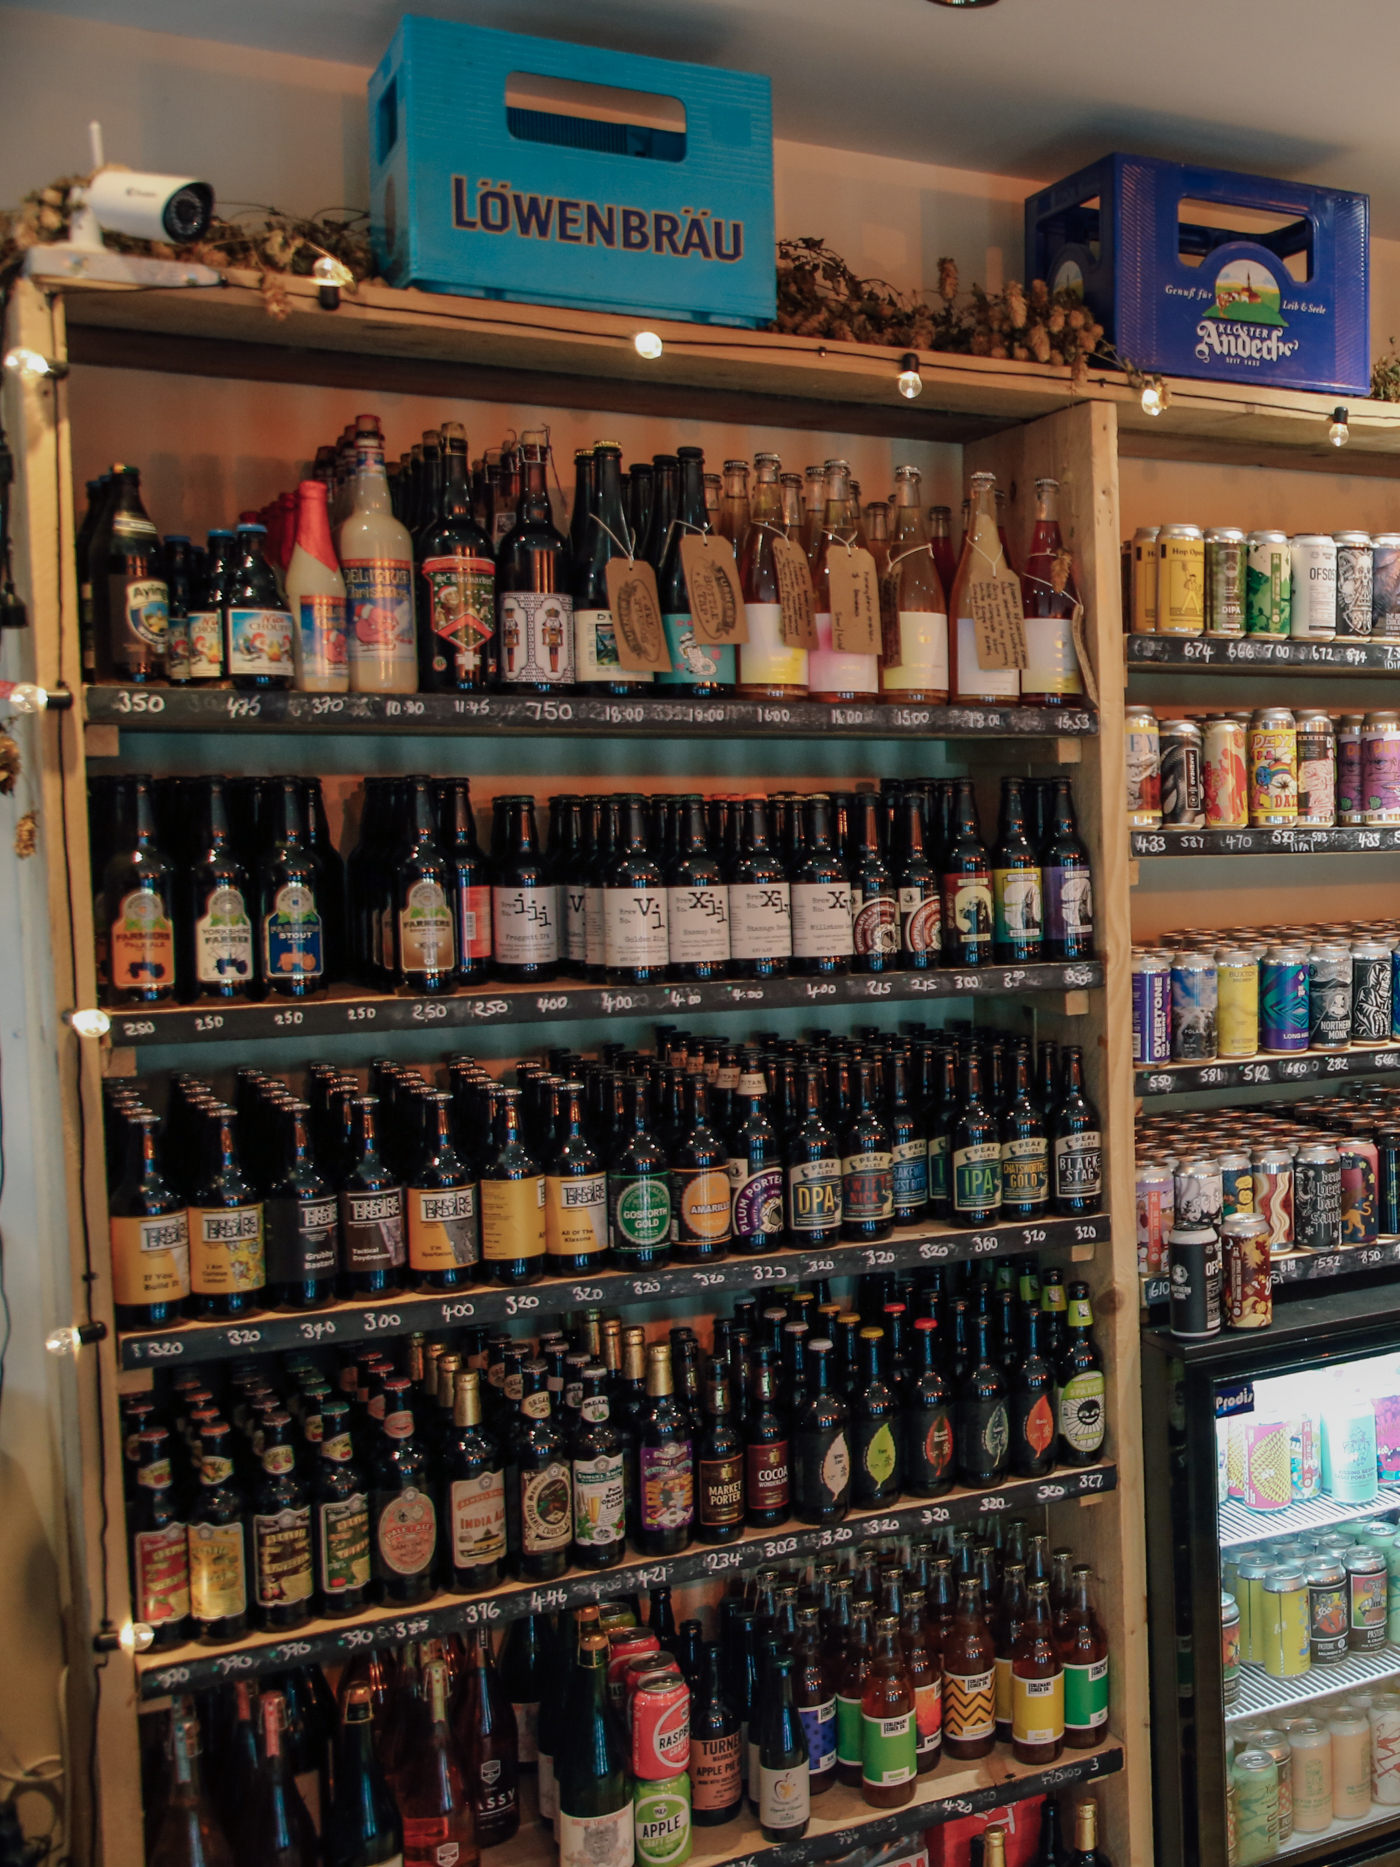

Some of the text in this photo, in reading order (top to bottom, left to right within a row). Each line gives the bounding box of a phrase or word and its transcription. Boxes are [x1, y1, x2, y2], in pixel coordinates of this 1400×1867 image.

[451, 174, 743, 263] LÖWENBRÄU
[1199, 289, 1213, 300] für
[1282, 300, 1299, 311] Leib
[1308, 303, 1326, 314] Seele
[1218, 325, 1269, 338] KLOSTER
[1196, 321, 1299, 363] Andechs
[1222, 606, 1241, 615] DIPA
[1184, 642, 1213, 663] 674
[1266, 645, 1289, 658] 700
[1312, 647, 1334, 661] 672
[119, 693, 165, 714] 350
[312, 698, 344, 715] 370
[529, 700, 572, 720] 750
[1226, 834, 1251, 848] 470
[279, 932, 313, 940] STOUT
[275, 1011, 304, 1026] 250
[347, 1007, 377, 1021] 250
[413, 1004, 448, 1020] 250
[1154, 977, 1163, 1058] OVERTONE
[124, 1022, 155, 1036] 250
[195, 1015, 224, 1031] 250
[1328, 1031, 1347, 1039] MONK
[1327, 1057, 1348, 1071] 282
[973, 1146, 995, 1154] PEAK
[1016, 1141, 1041, 1149] PEAK
[811, 1162, 836, 1171] PEAK
[858, 1156, 885, 1164] PEAK
[1059, 1154, 1099, 1171] BLACK
[816, 1168, 833, 1176] ALES
[1003, 1163, 1044, 1175] CHATSWORTH
[1066, 1169, 1094, 1182] STAG
[965, 1169, 993, 1194] IPA
[1010, 1172, 1038, 1188] GOLD
[799, 1186, 836, 1215] DPA
[624, 1208, 667, 1219] GOSFORTH
[690, 1202, 730, 1214] AMARILLO
[635, 1218, 659, 1228] GOLD
[1023, 1230, 1046, 1245] 320
[1075, 1225, 1097, 1240] 320
[305, 1251, 334, 1262] Grubby
[352, 1247, 379, 1255] Tactical
[1362, 1251, 1380, 1265] 850
[305, 1258, 335, 1270] Bastard
[1318, 1256, 1341, 1269] 552
[155, 1272, 173, 1280] You
[506, 1295, 539, 1313] 320
[442, 1303, 475, 1324] 400
[364, 1314, 400, 1331] 300
[227, 1329, 261, 1345] 320
[148, 1342, 184, 1357] 320
[1216, 1391, 1254, 1408] Prodis
[758, 1466, 788, 1482] COCOA
[709, 1483, 741, 1496] MARKET
[710, 1492, 741, 1505] PORTER
[460, 1517, 488, 1530] INDIA
[921, 1508, 949, 1525] 320
[707, 1552, 743, 1573] 234
[697, 1763, 735, 1776] APPLE PIE
[643, 1815, 680, 1838] APPLE
[643, 1829, 683, 1848] CRAFT CIDER
